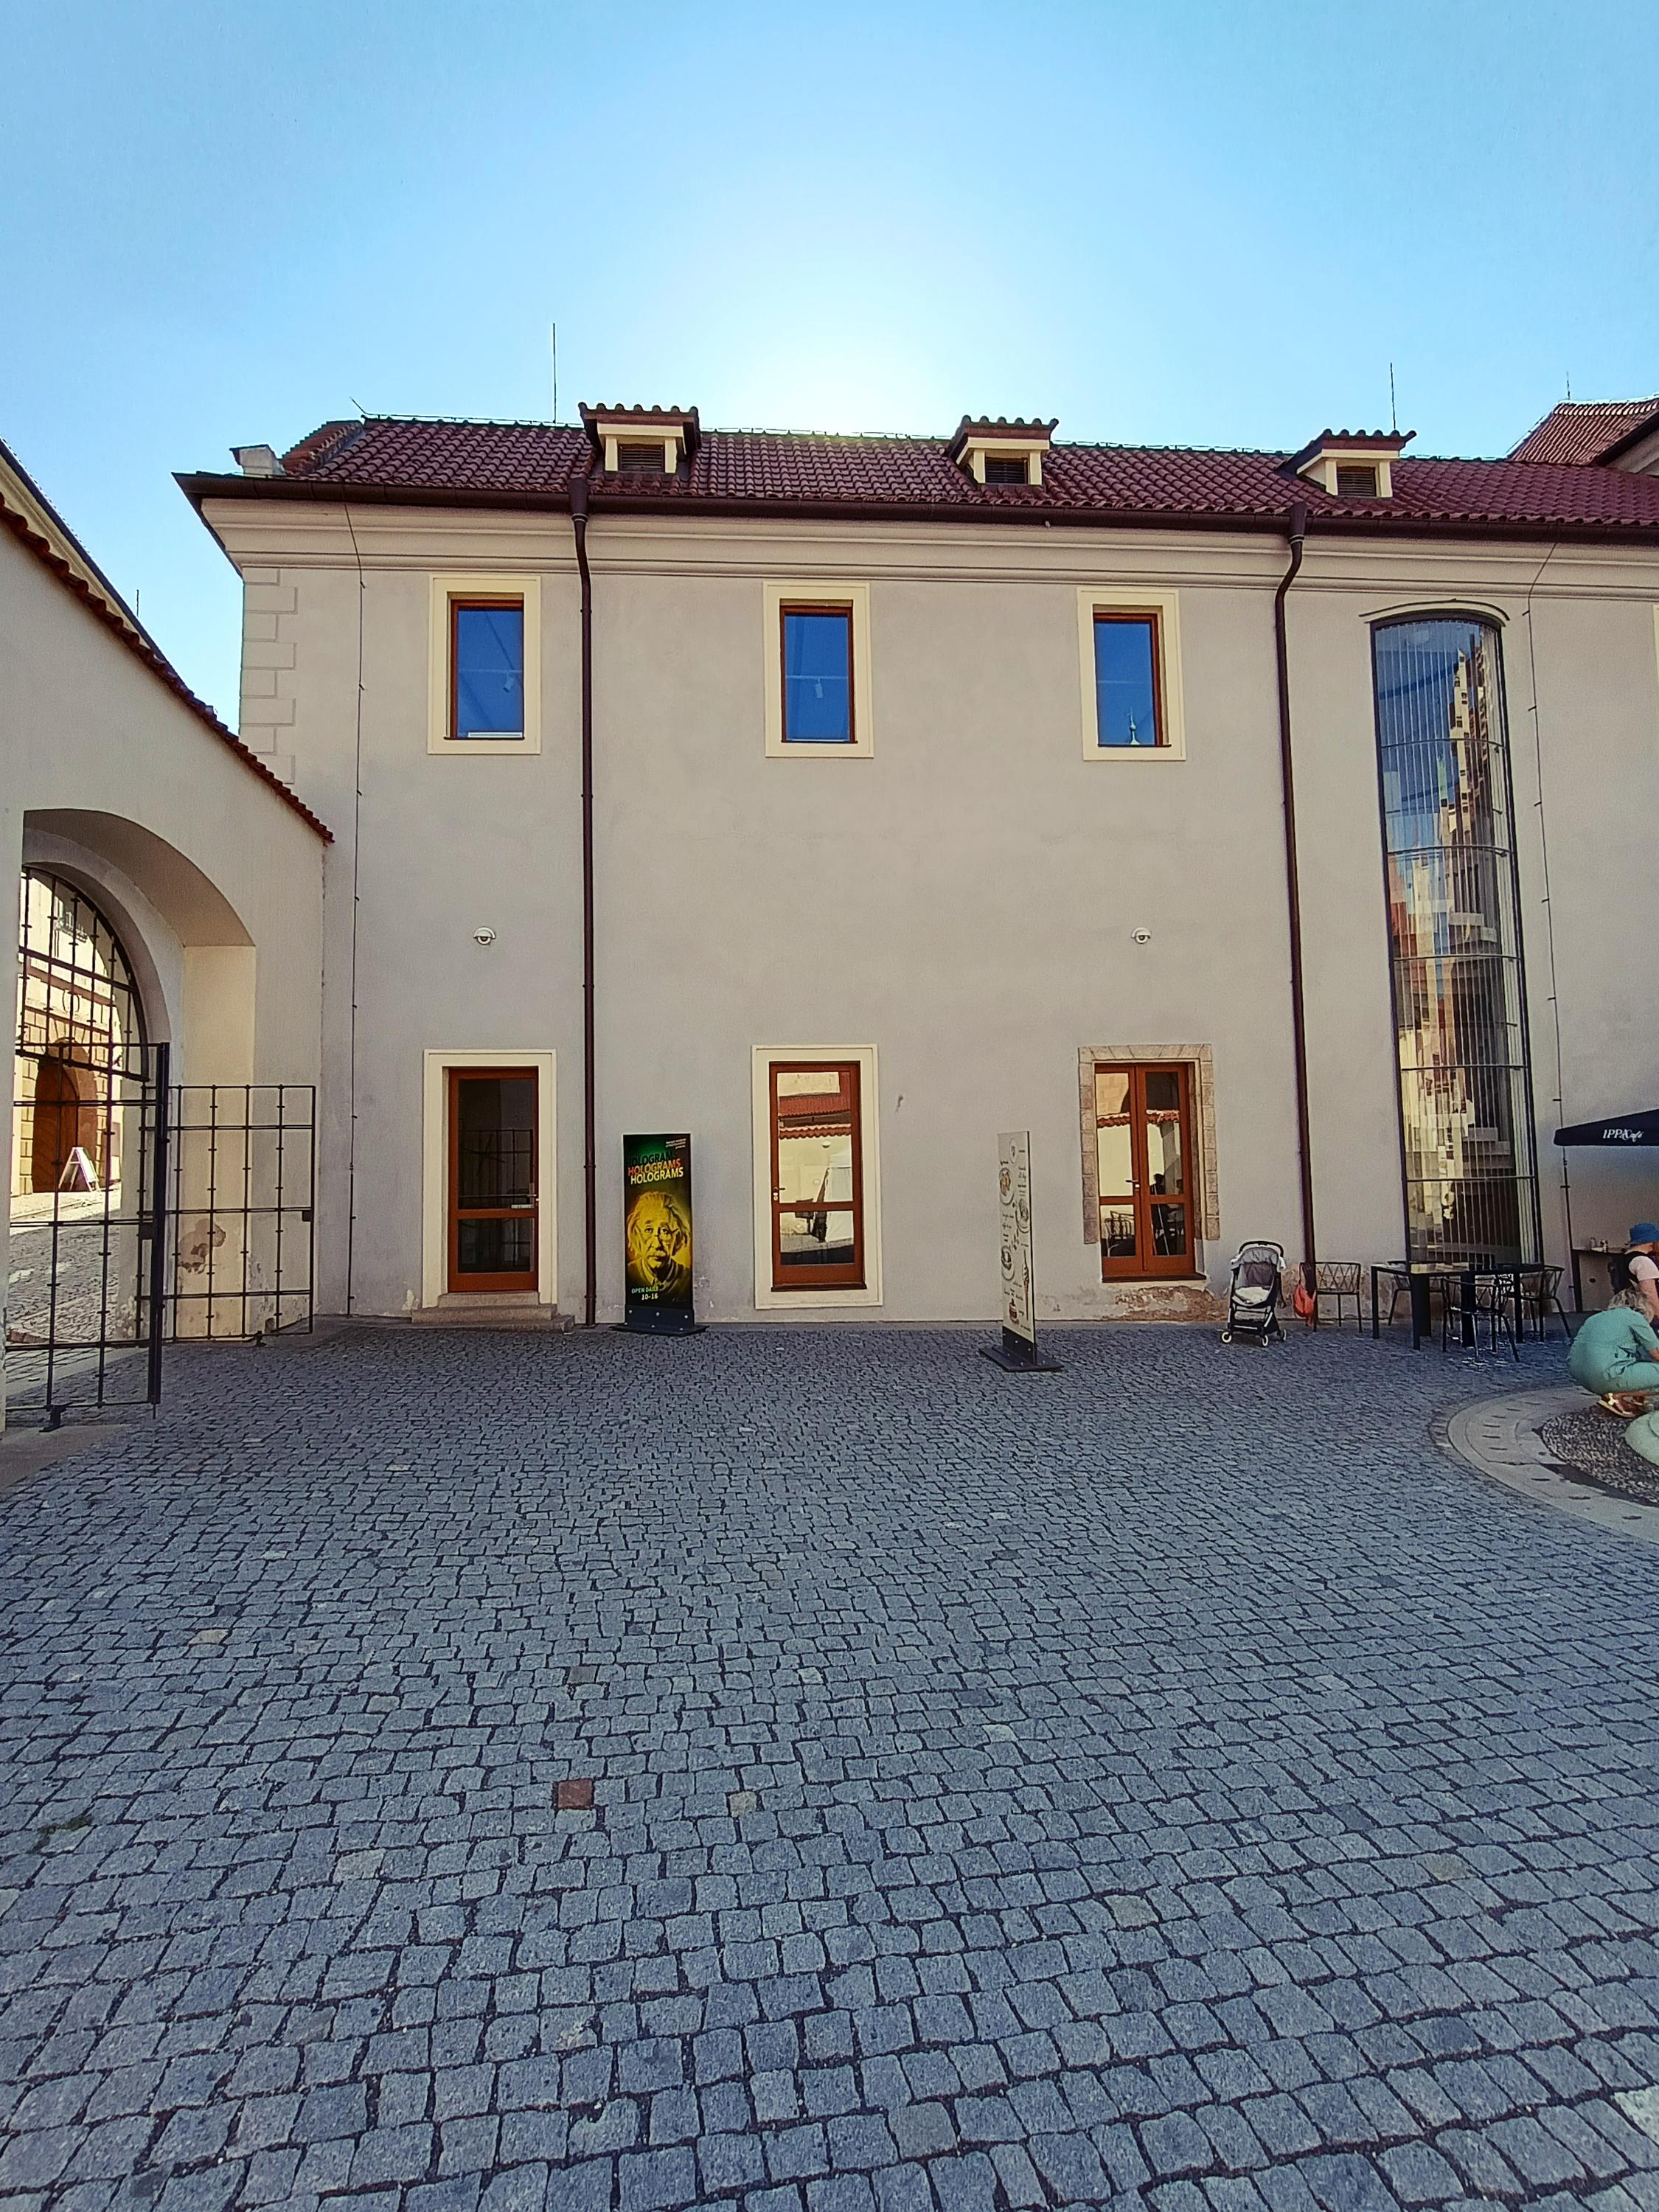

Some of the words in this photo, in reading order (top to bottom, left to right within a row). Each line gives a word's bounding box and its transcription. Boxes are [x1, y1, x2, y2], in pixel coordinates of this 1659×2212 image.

[627, 1158, 681, 1176] HOLOGRAMS
[630, 1167, 684, 1185] HOLOGRAMS
[641, 1293, 658, 1301] 10-16
